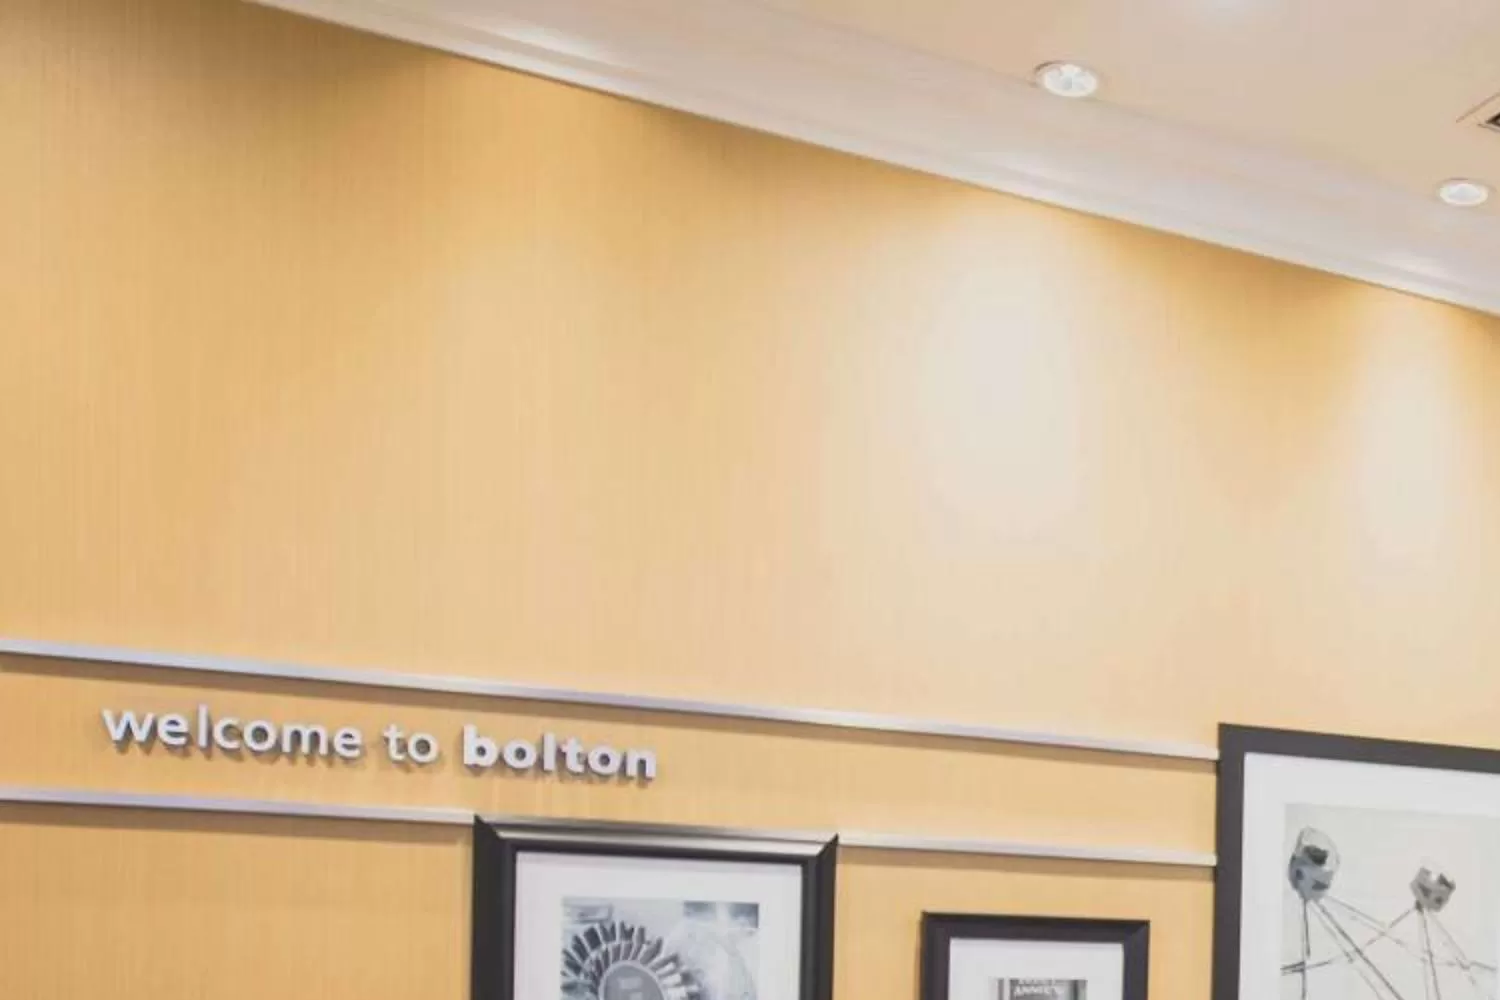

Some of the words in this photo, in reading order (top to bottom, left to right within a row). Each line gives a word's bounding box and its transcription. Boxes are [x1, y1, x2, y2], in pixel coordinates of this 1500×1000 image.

[102, 705, 362, 760] welcome
[383, 722, 440, 764] to
[463, 724, 658, 779] bolton
